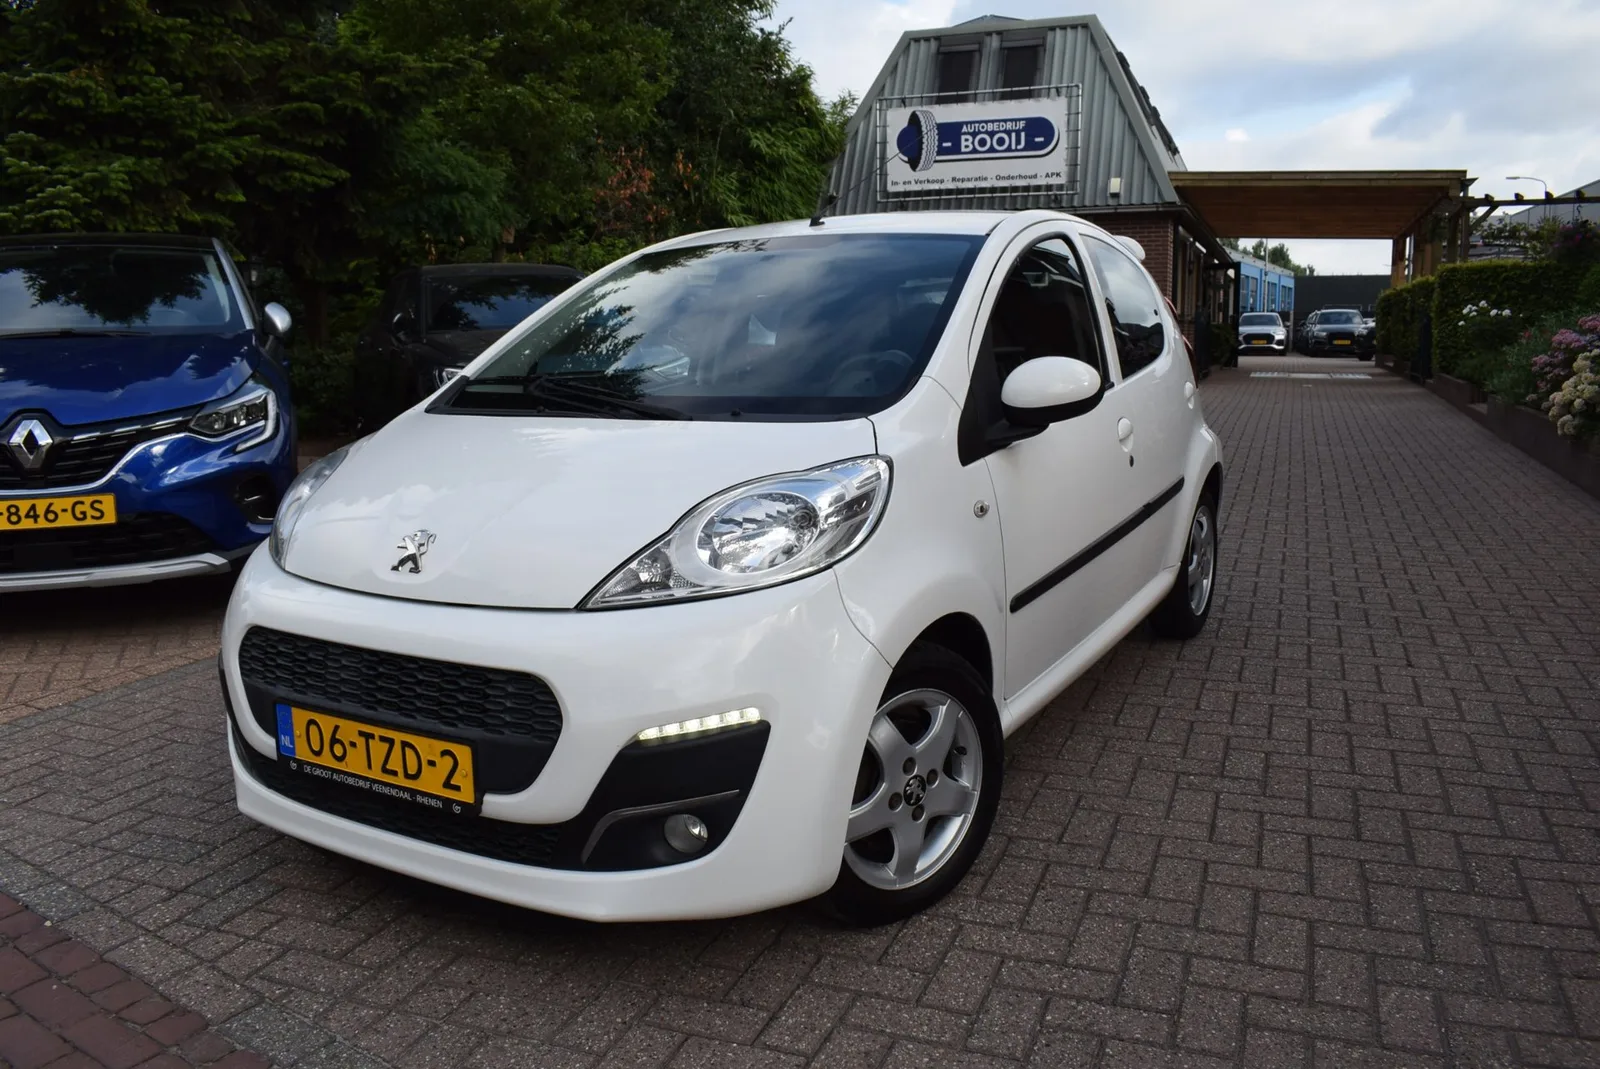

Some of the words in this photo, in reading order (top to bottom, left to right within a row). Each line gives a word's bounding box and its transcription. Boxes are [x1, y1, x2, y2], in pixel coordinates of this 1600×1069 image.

[961, 120, 1026, 133] AUTOBEDRIJF
[960, 132, 1026, 152] BOOIJ
[913, 177, 945, 185] Verkoop
[951, 175, 988, 183] Reparatie
[995, 173, 1037, 181] Onderhoud
[281, 734, 293, 748] NL
[305, 718, 462, 792] 06-TZD-2
[303, 764, 312, 773] DE
[312, 767, 332, 779] GROOT
[333, 774, 371, 789] AUTOBEDRIJF
[371, 783, 412, 800] VEENENDAAL
[416, 795, 443, 808] RHENEN
